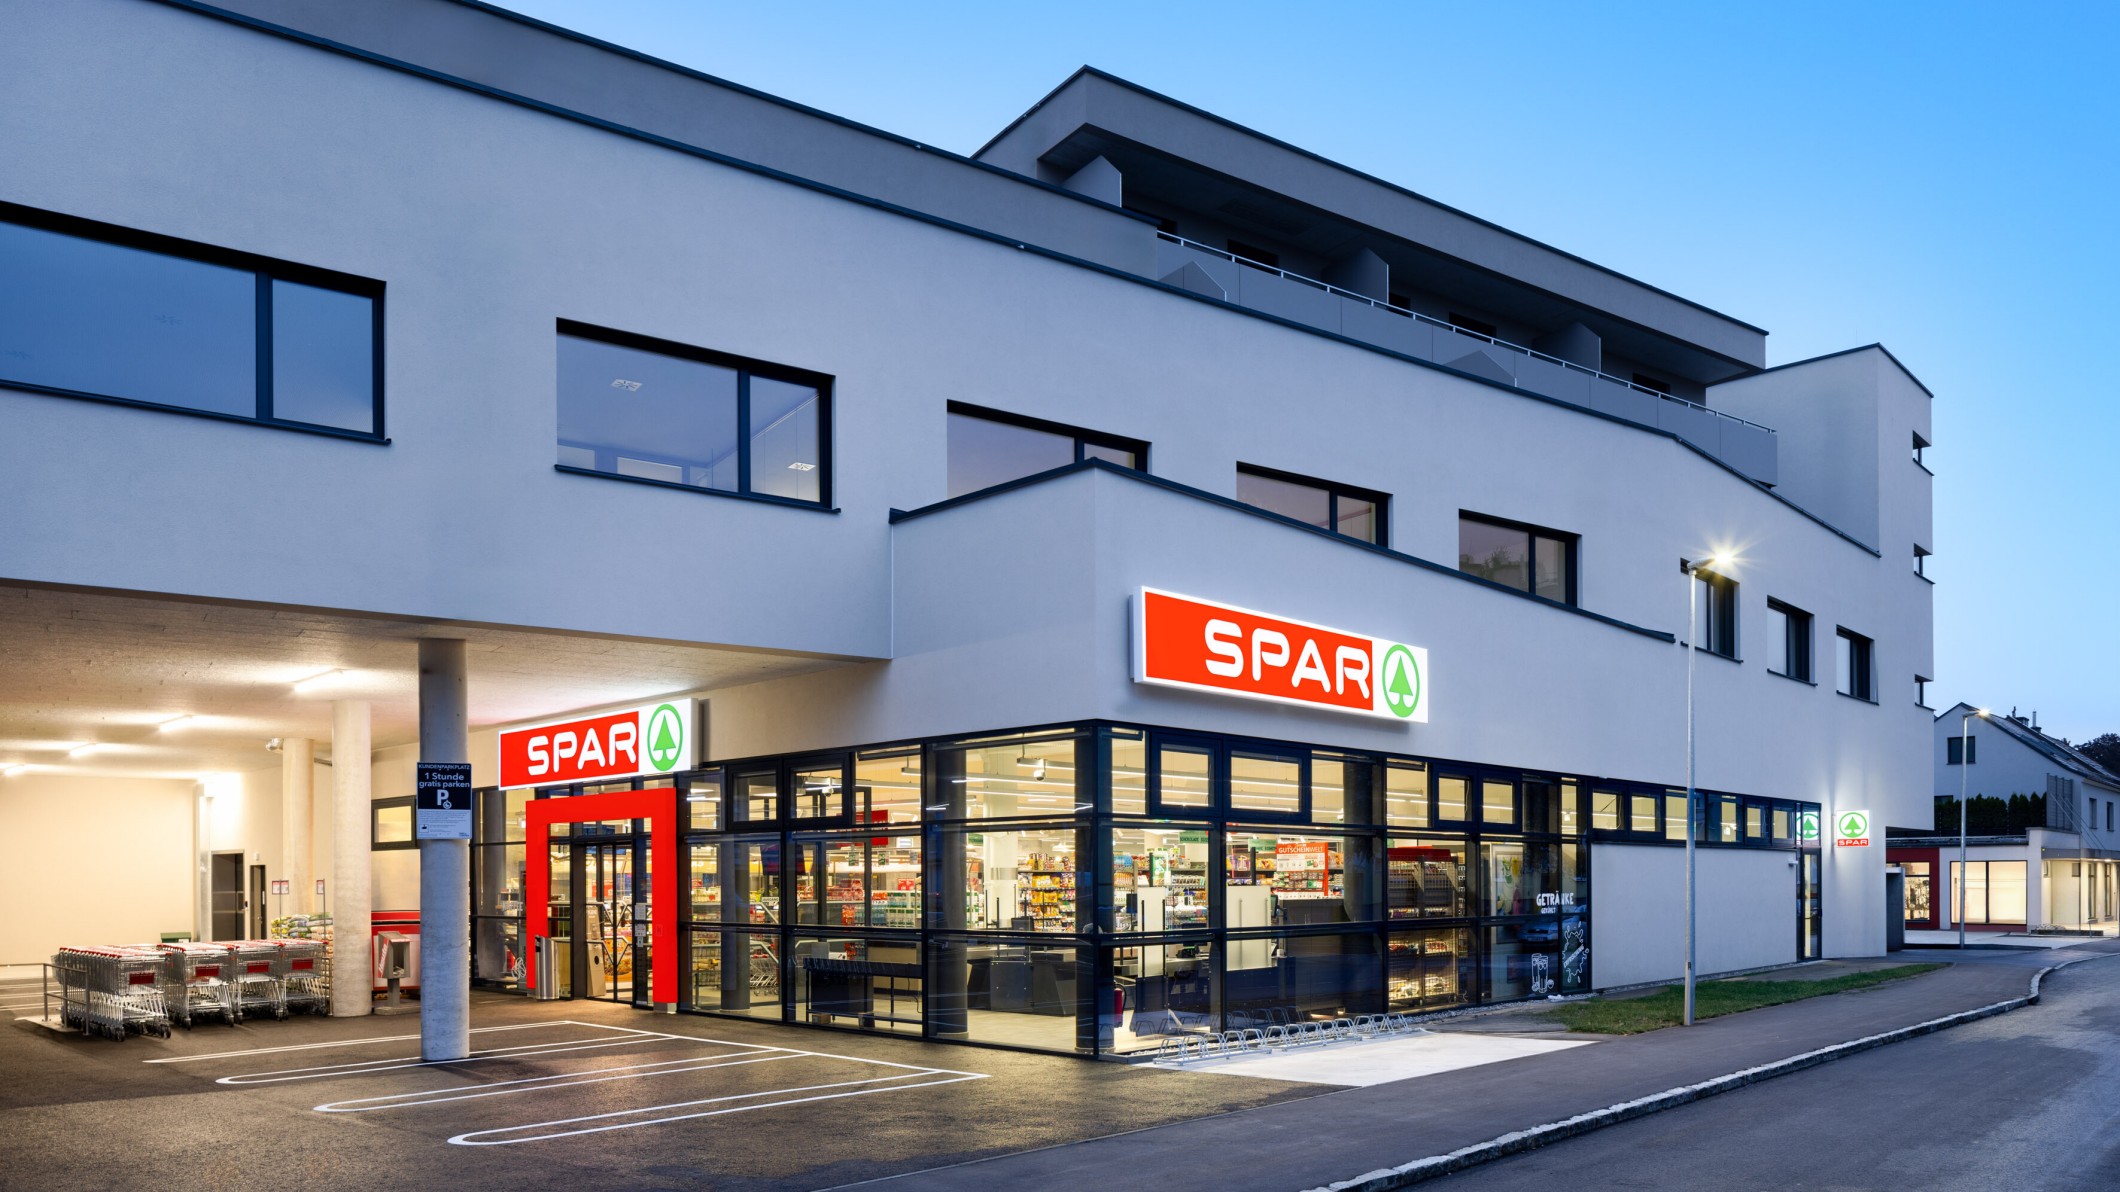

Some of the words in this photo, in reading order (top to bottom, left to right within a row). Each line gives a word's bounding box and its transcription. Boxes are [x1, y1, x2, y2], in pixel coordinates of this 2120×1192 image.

[1204, 618, 1370, 699] SPAR
[527, 721, 637, 776] SPAR
[424, 772, 430, 780] 1
[432, 772, 465, 780] Stunde
[419, 780, 441, 788] gratis
[442, 780, 470, 788] parken
[1278, 846, 1323, 854] GUTSCHEINWELT
